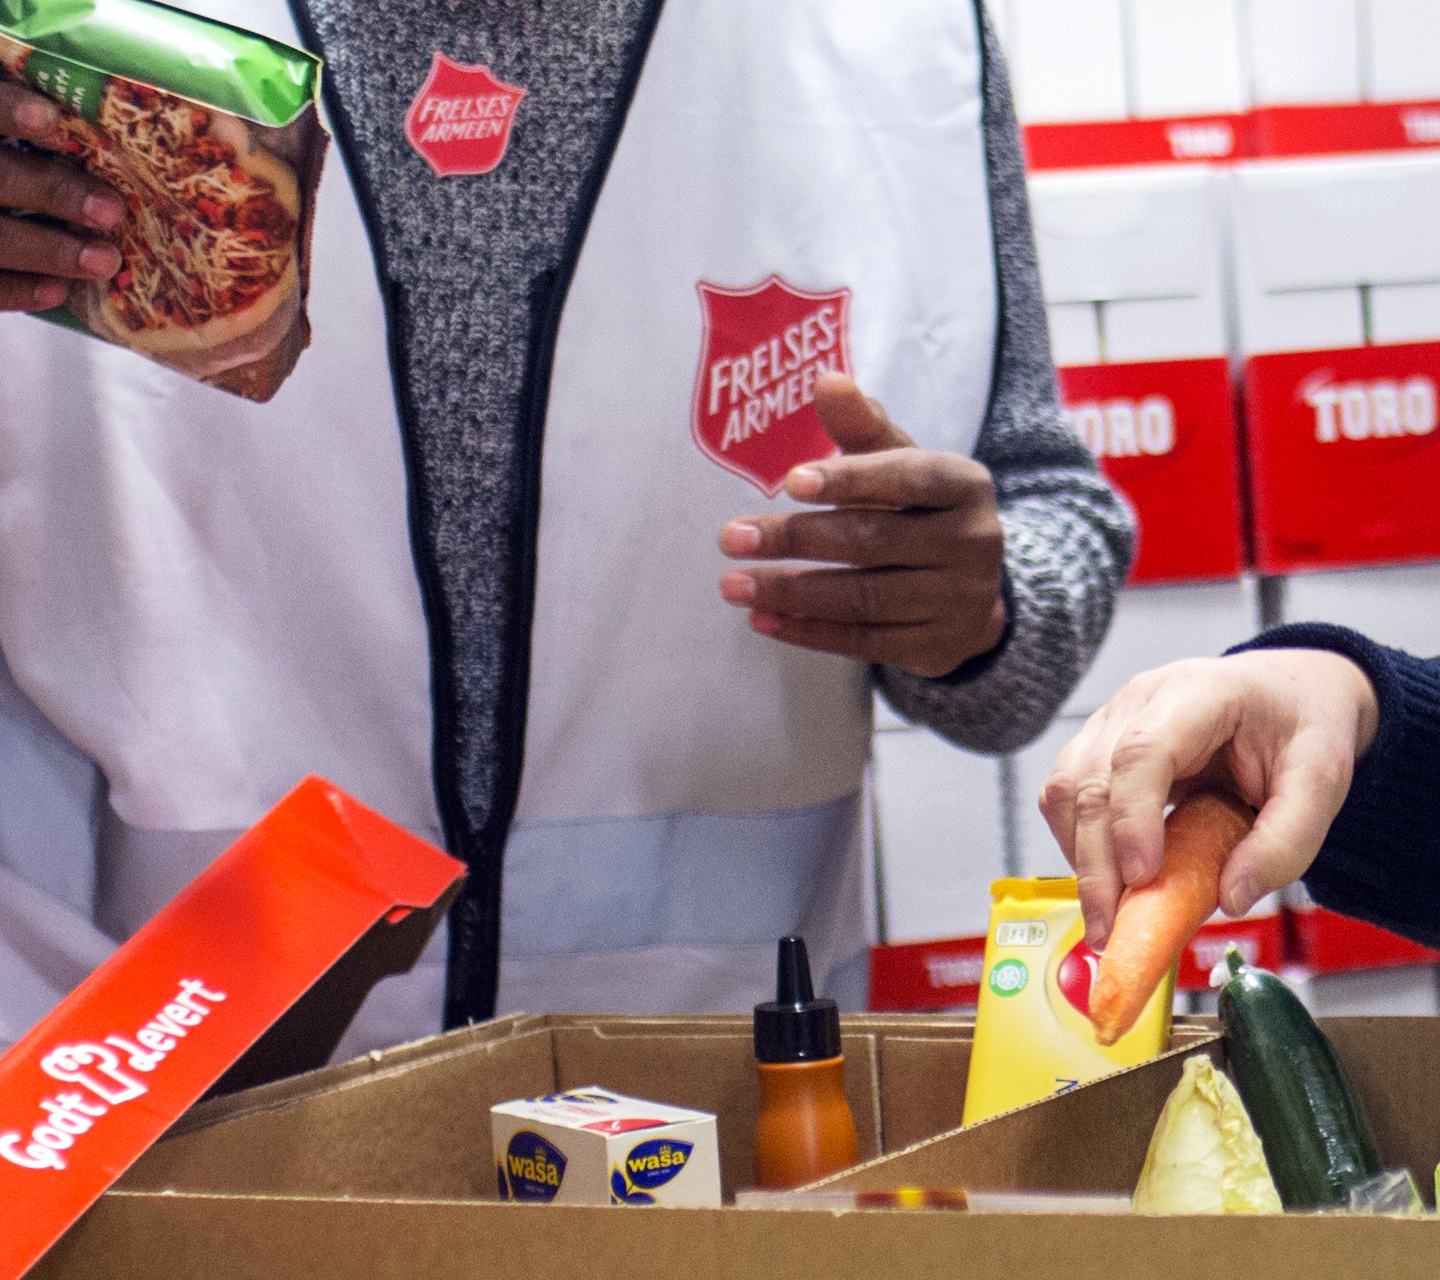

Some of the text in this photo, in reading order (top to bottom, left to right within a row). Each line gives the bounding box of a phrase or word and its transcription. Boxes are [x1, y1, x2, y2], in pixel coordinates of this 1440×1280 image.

[420, 120, 503, 143] ARMEEN
[1303, 378, 1437, 441] TORO
[1061, 394, 1175, 458] ORO
[510, 1155, 559, 1186] wasa
[627, 1150, 685, 1173] wasa
